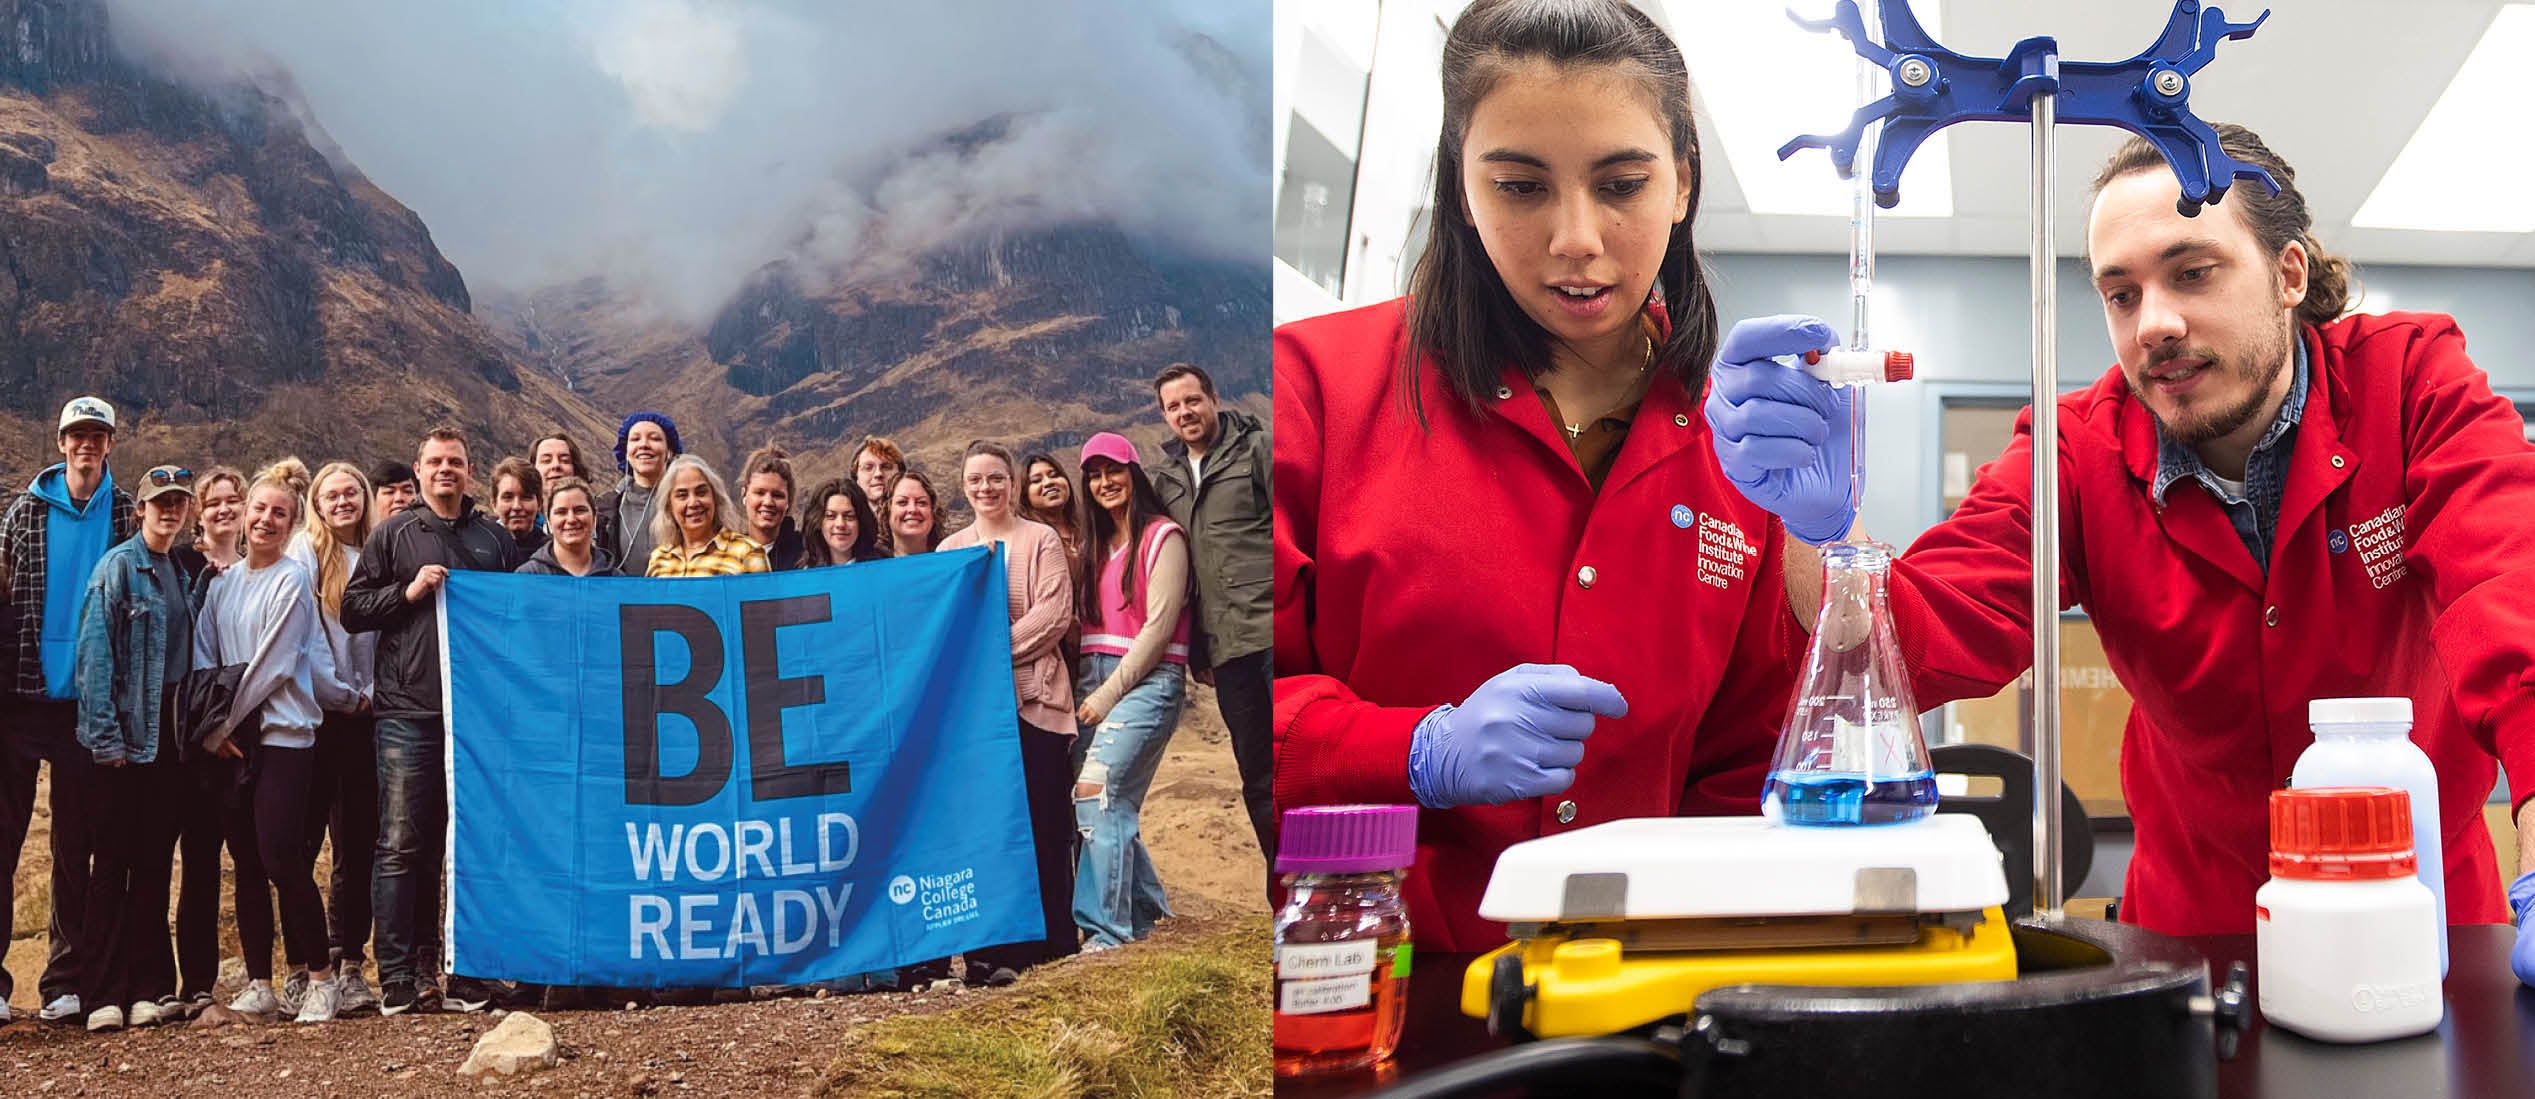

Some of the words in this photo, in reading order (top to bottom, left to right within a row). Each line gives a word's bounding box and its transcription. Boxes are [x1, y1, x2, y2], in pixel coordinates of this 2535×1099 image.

[2349, 504, 2406, 537] Canadian
[1699, 538, 1744, 565] Institute
[2360, 535, 2404, 564] Institut
[1697, 553, 1744, 581] Innovation
[1697, 568, 1728, 589] Centre
[2372, 566, 2407, 589] Centre
[619, 592, 851, 806] BE
[625, 812, 859, 881] WORLD
[920, 867, 974, 890] Niagara
[921, 882, 975, 906] College
[923, 893, 977, 921] Canada
[629, 882, 854, 960] READY
[1288, 953, 1329, 969] Chem
[1334, 951, 1363, 967] Lab
